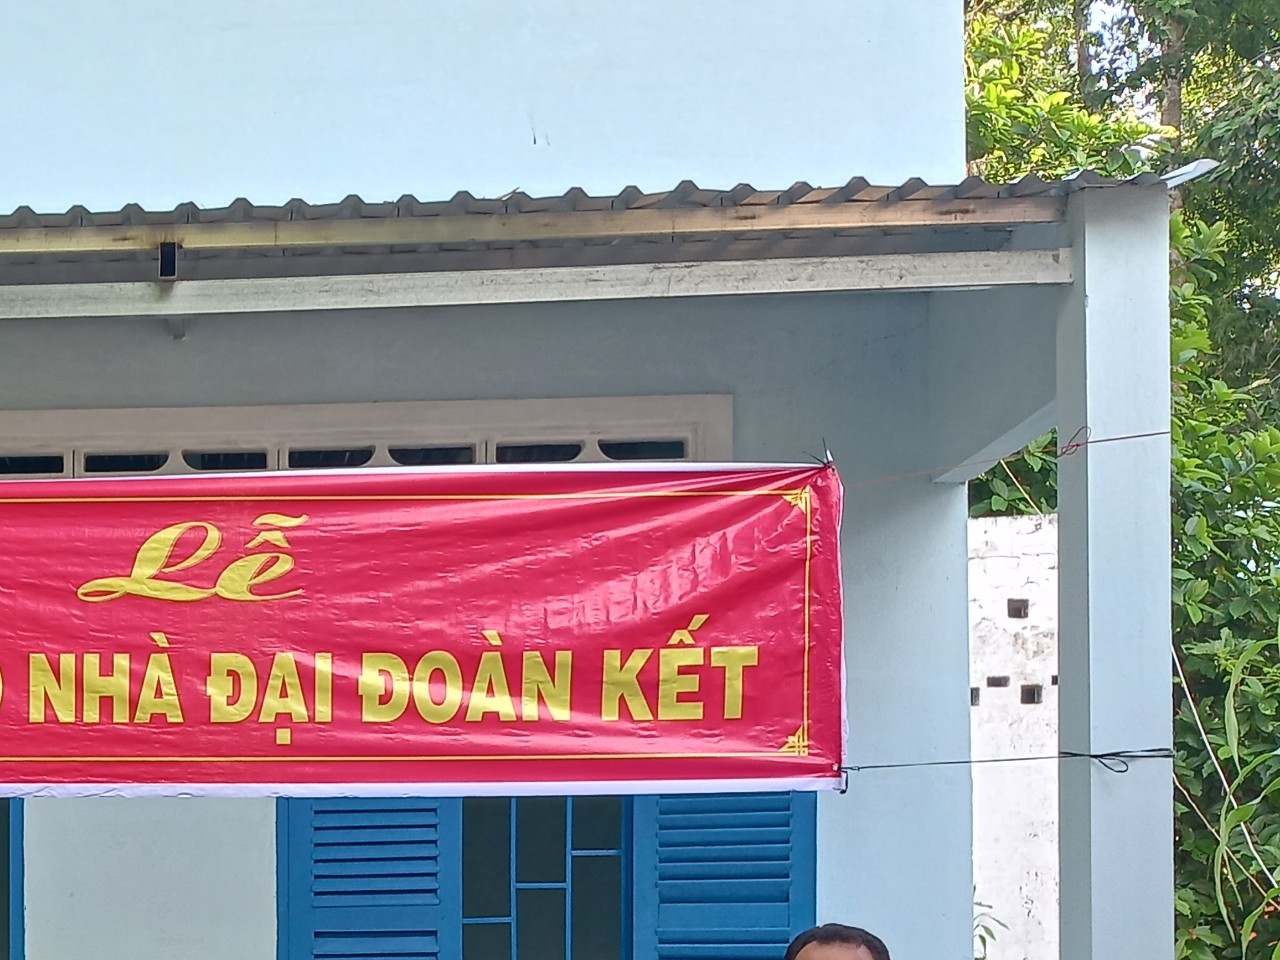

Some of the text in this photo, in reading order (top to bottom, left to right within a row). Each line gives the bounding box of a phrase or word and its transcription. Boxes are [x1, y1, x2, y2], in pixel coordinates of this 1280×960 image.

[77, 513, 310, 602] Lễ
[28, 631, 184, 723] NHÀ
[205, 652, 333, 745] ĐẠI
[357, 629, 572, 722] ĐOÀN
[602, 612, 759, 721] KẾT
